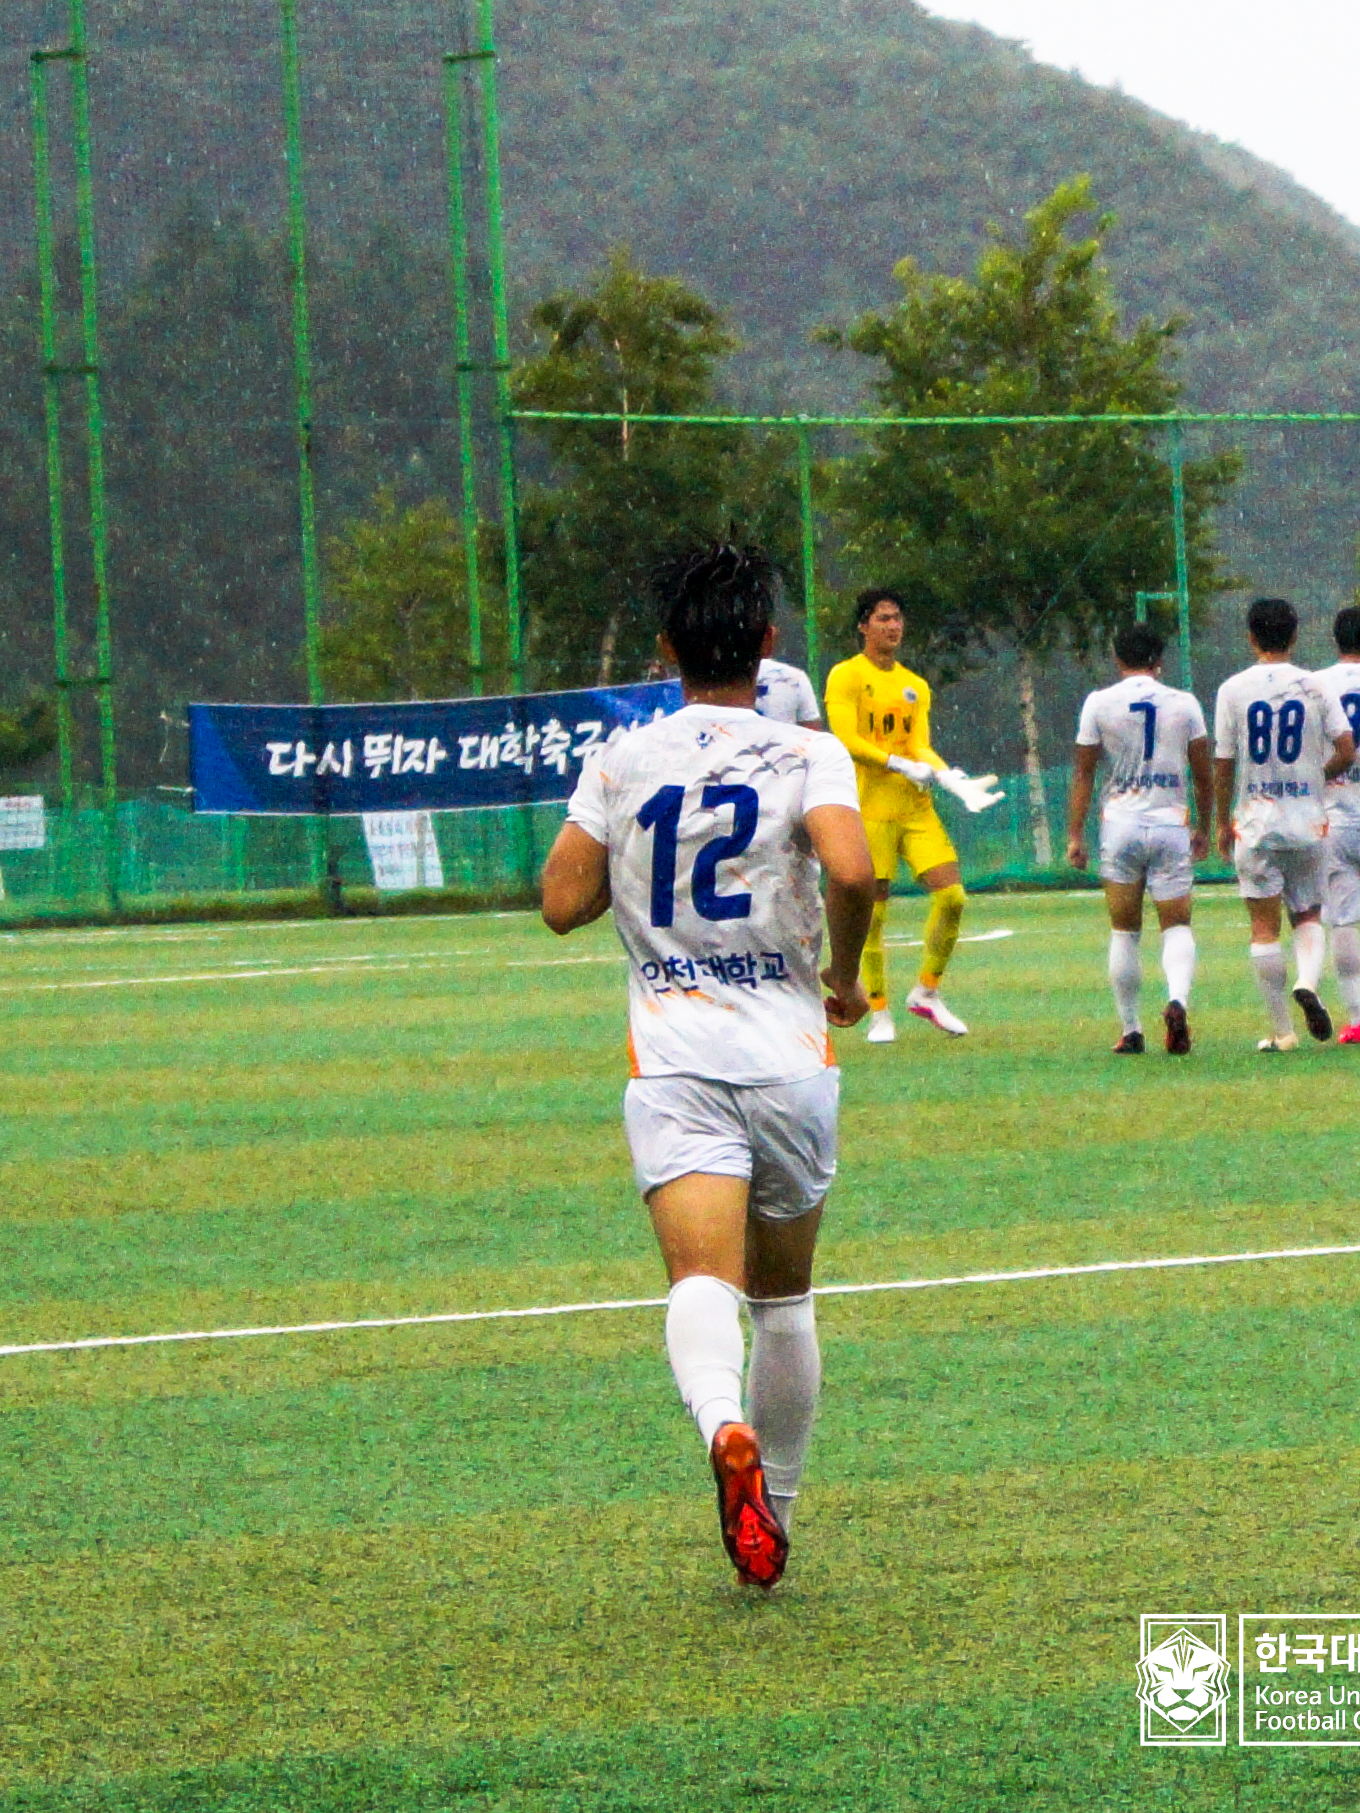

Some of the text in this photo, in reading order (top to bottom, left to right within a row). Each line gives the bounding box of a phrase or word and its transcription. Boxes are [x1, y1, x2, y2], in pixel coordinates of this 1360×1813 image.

[266, 738, 353, 778] 다시
[363, 732, 447, 779] 뛰자
[1129, 701, 1157, 761] 7
[1247, 699, 1305, 765] 88
[636, 784, 759, 927] 12
[640, 951, 789, 992] 인천대학교
